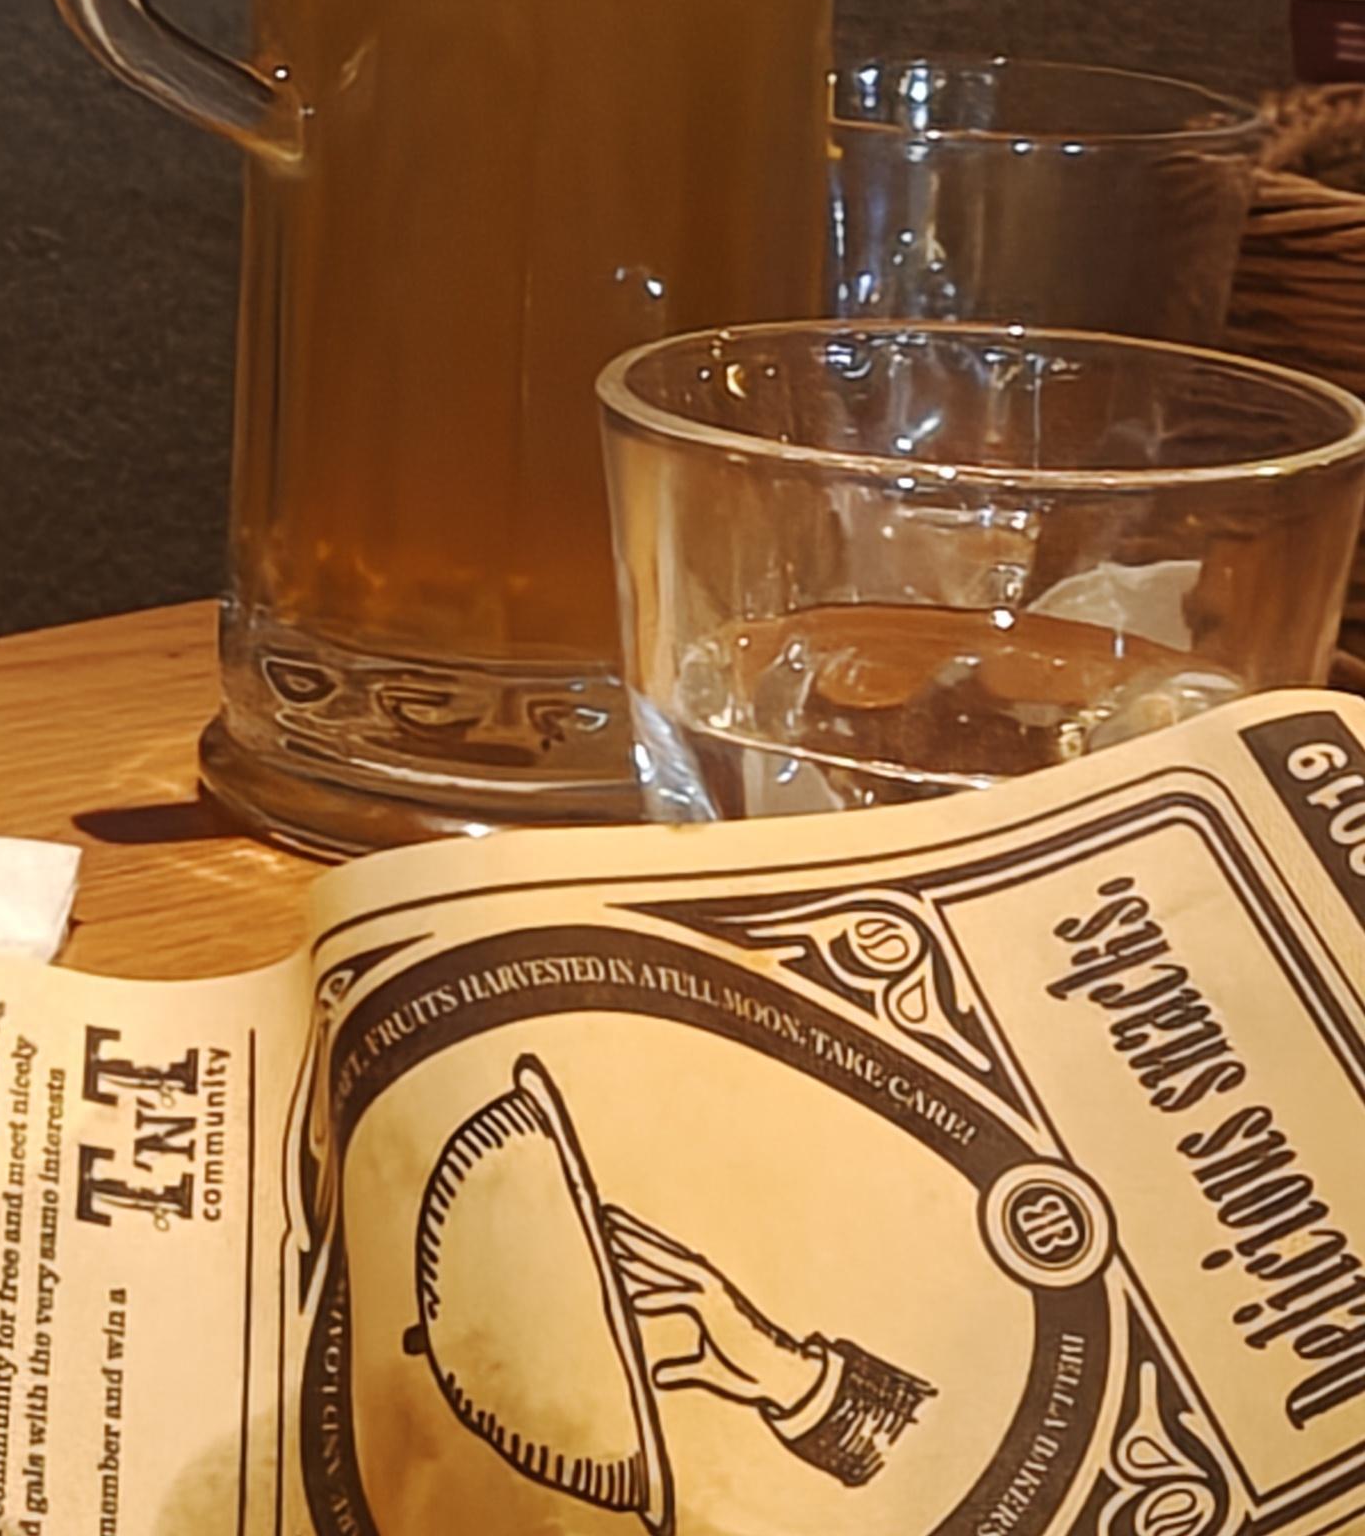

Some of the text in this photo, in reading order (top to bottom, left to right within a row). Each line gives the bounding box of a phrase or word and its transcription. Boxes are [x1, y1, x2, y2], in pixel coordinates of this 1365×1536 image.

[364, 984, 459, 1057] FRUITS
[459, 956, 605, 1004] HARVESTED
[609, 957, 636, 984] IN
[1045, 876, 1248, 1114] snacks.
[9, 1034, 39, 1115] nicely
[8, 1120, 29, 1188] meet
[38, 1066, 67, 1184] interests
[201, 1046, 231, 1222] community
[2, 1190, 24, 1244] and
[38, 1188, 60, 1262] same
[35, 1262, 61, 1326] very
[109, 1287, 128, 1305] a
[28, 1332, 52, 1377] the
[101, 1309, 127, 1361] win
[24, 1383, 49, 1446] with
[100, 1366, 124, 1420] and
